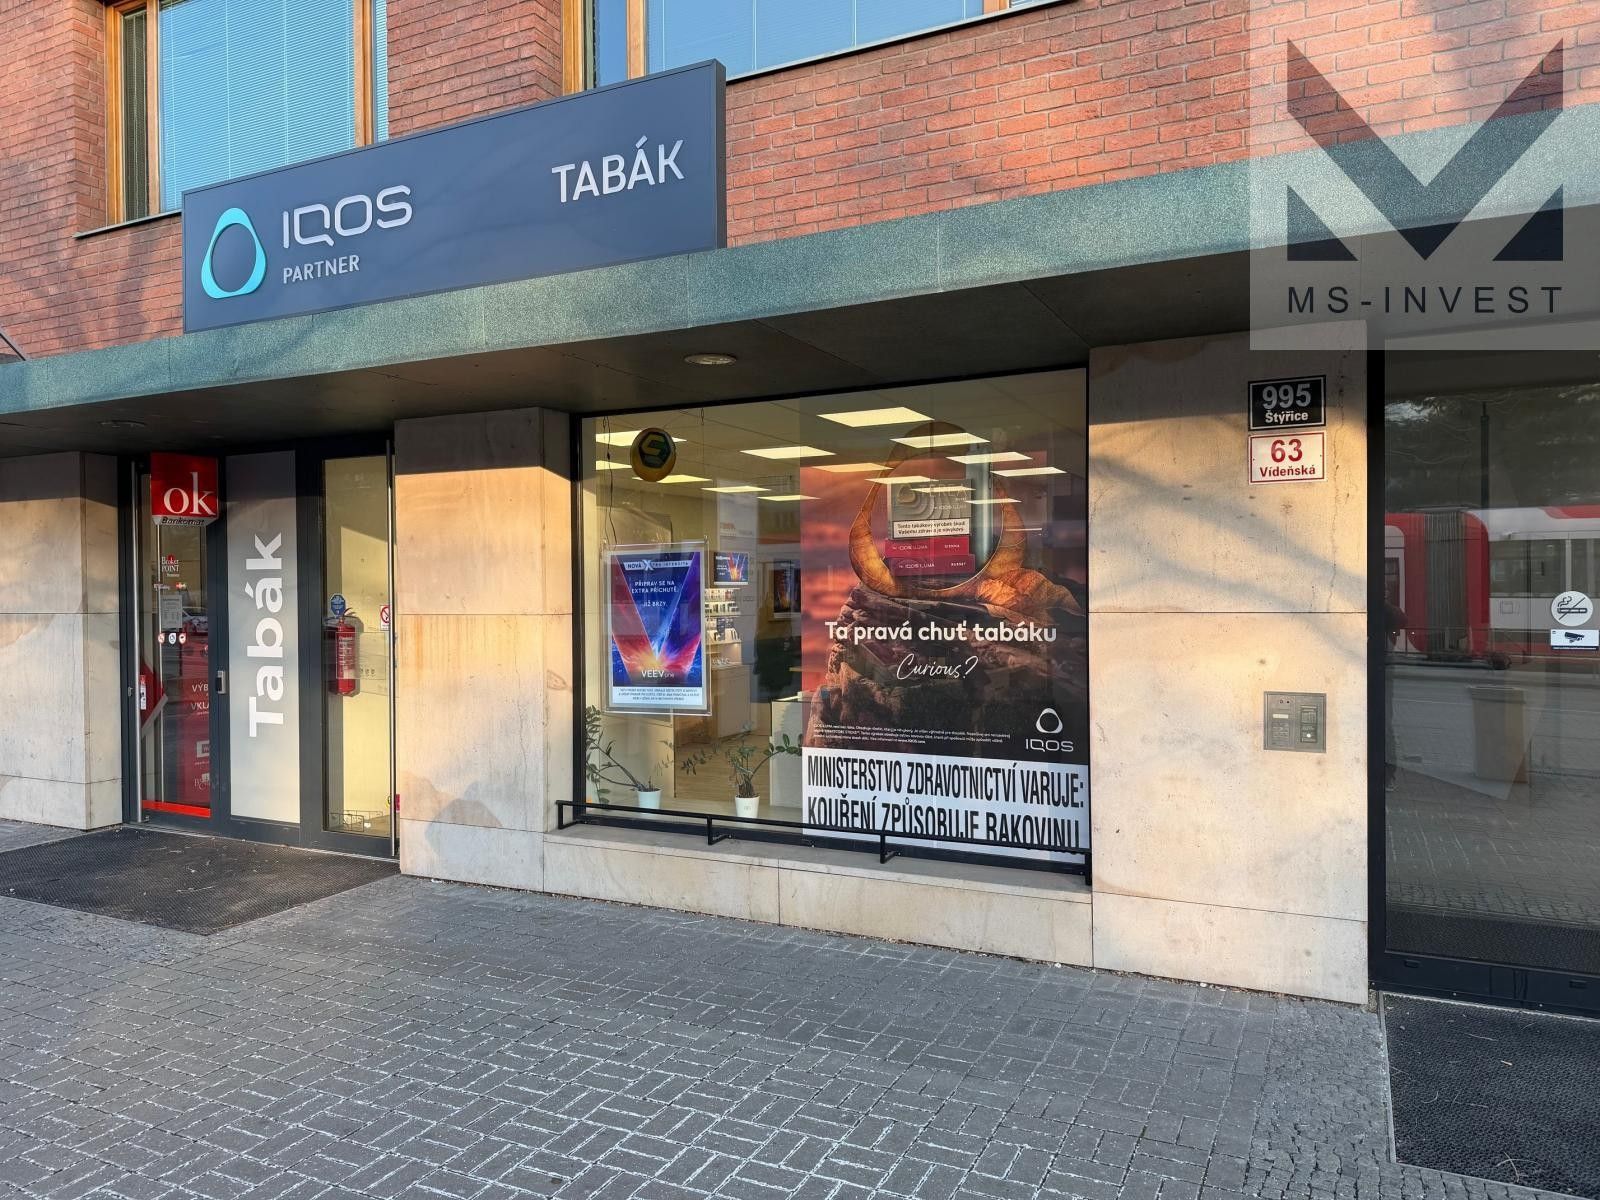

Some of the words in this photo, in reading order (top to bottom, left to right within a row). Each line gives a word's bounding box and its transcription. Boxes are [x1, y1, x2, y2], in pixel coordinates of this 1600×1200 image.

[552, 135, 684, 202] TABÁK
[282, 184, 413, 248] IQOS
[283, 254, 360, 284] PARTNER
[1262, 384, 1312, 410] 995
[1265, 410, 1308, 424] Štýřice
[1270, 438, 1303, 462] 63
[1260, 464, 1316, 477] Vídeňská
[164, 472, 216, 516] ok
[245, 532, 284, 737] Tabák
[825, 622, 848, 640] Ta
[854, 621, 912, 644] pravá
[918, 620, 967, 641] chuť
[974, 622, 1057, 642] tabáku
[641, 669, 664, 678] VEEV
[896, 653, 978, 680] Curious?
[1025, 739, 1074, 752] IQOS
[808, 755, 901, 793] MINISTERSTVO
[907, 762, 1017, 802] ZDRAVOTNICTVÍ
[1020, 770, 1084, 808] VARUJE:
